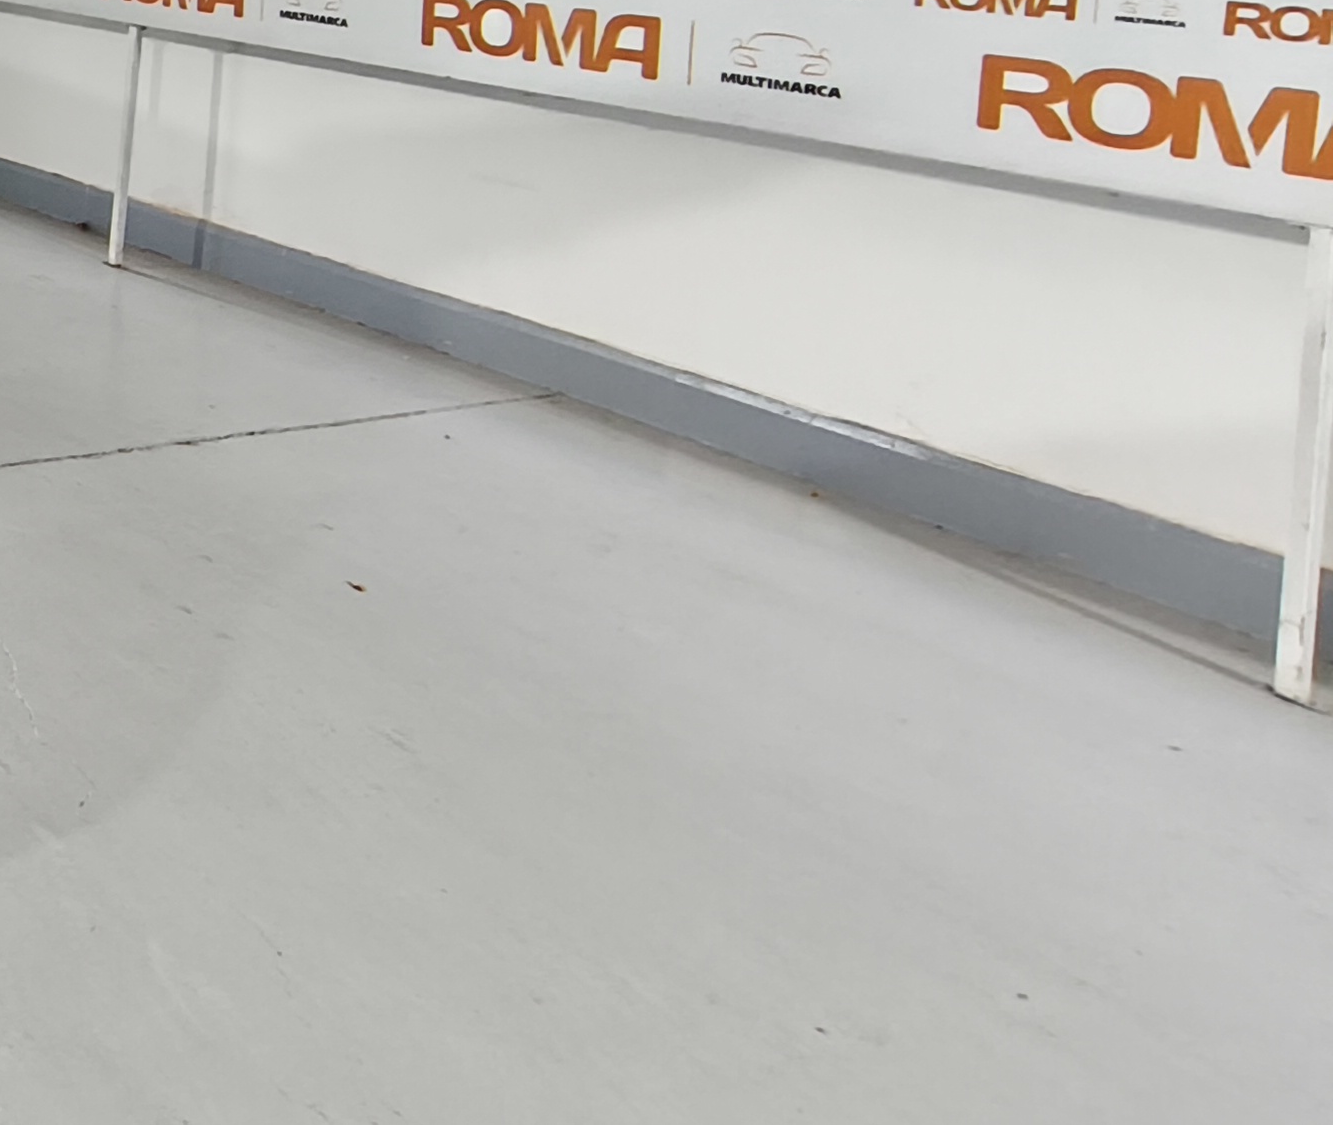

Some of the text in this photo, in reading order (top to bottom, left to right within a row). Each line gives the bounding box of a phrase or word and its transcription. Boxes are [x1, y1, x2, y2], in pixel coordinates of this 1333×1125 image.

[279, 9, 348, 27] MULTIMARCA
[1222, 1, 1333, 46] RO
[720, 71, 841, 99] MULTIMARCA
[976, 54, 1333, 182] ROM
